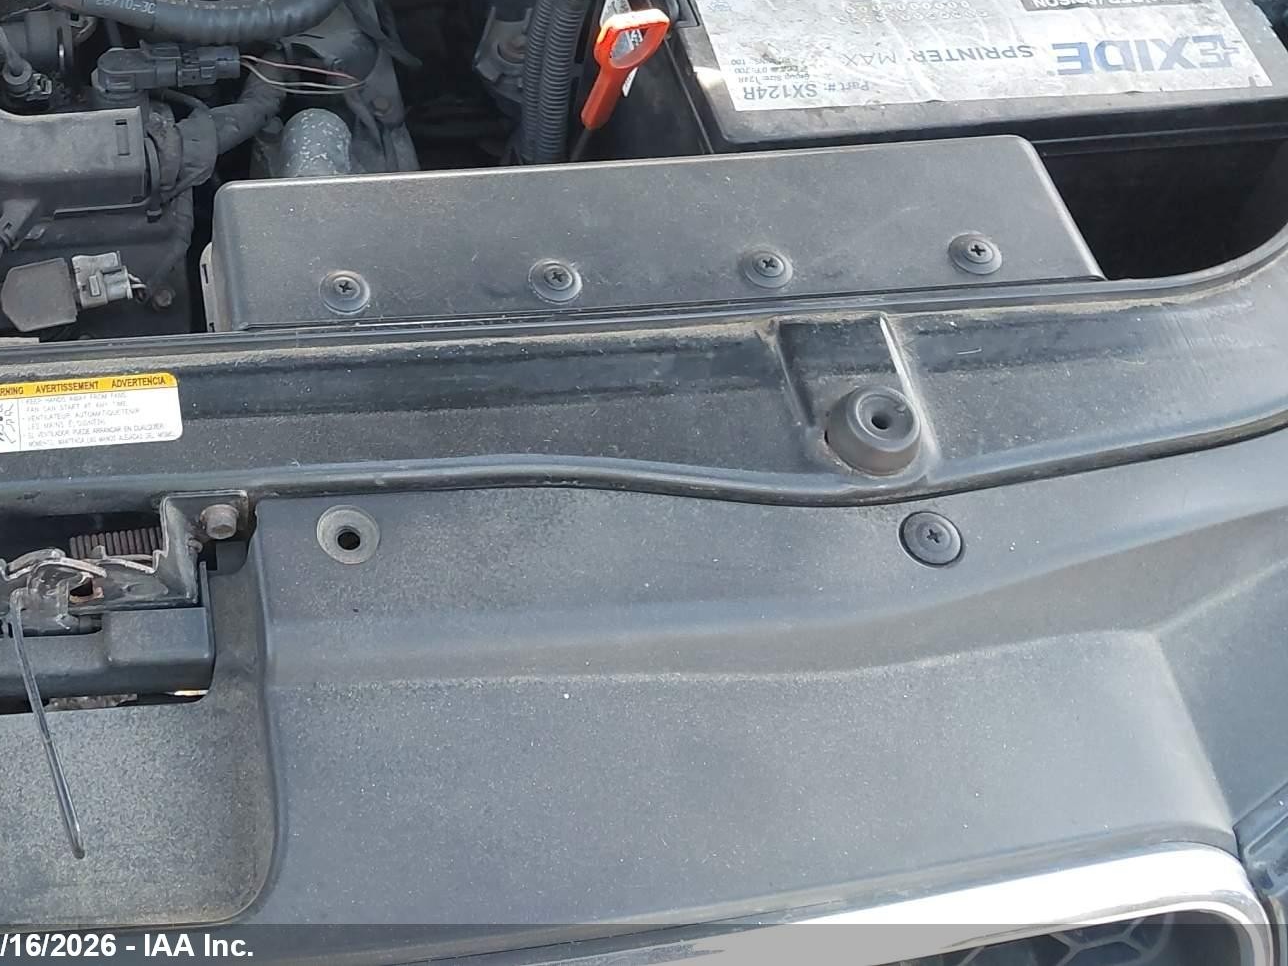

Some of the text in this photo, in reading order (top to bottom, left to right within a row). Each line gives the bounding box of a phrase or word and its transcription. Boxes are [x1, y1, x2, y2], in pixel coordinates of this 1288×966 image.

[842, 44, 1034, 67] SPRINTER MAX
[1052, 33, 1240, 76] EXIDE
[743, 80, 869, 101] Part #: SX124R
[35, 381, 99, 394] AVERTISSEMENT
[111, 376, 166, 388] ADVERTENCIA
